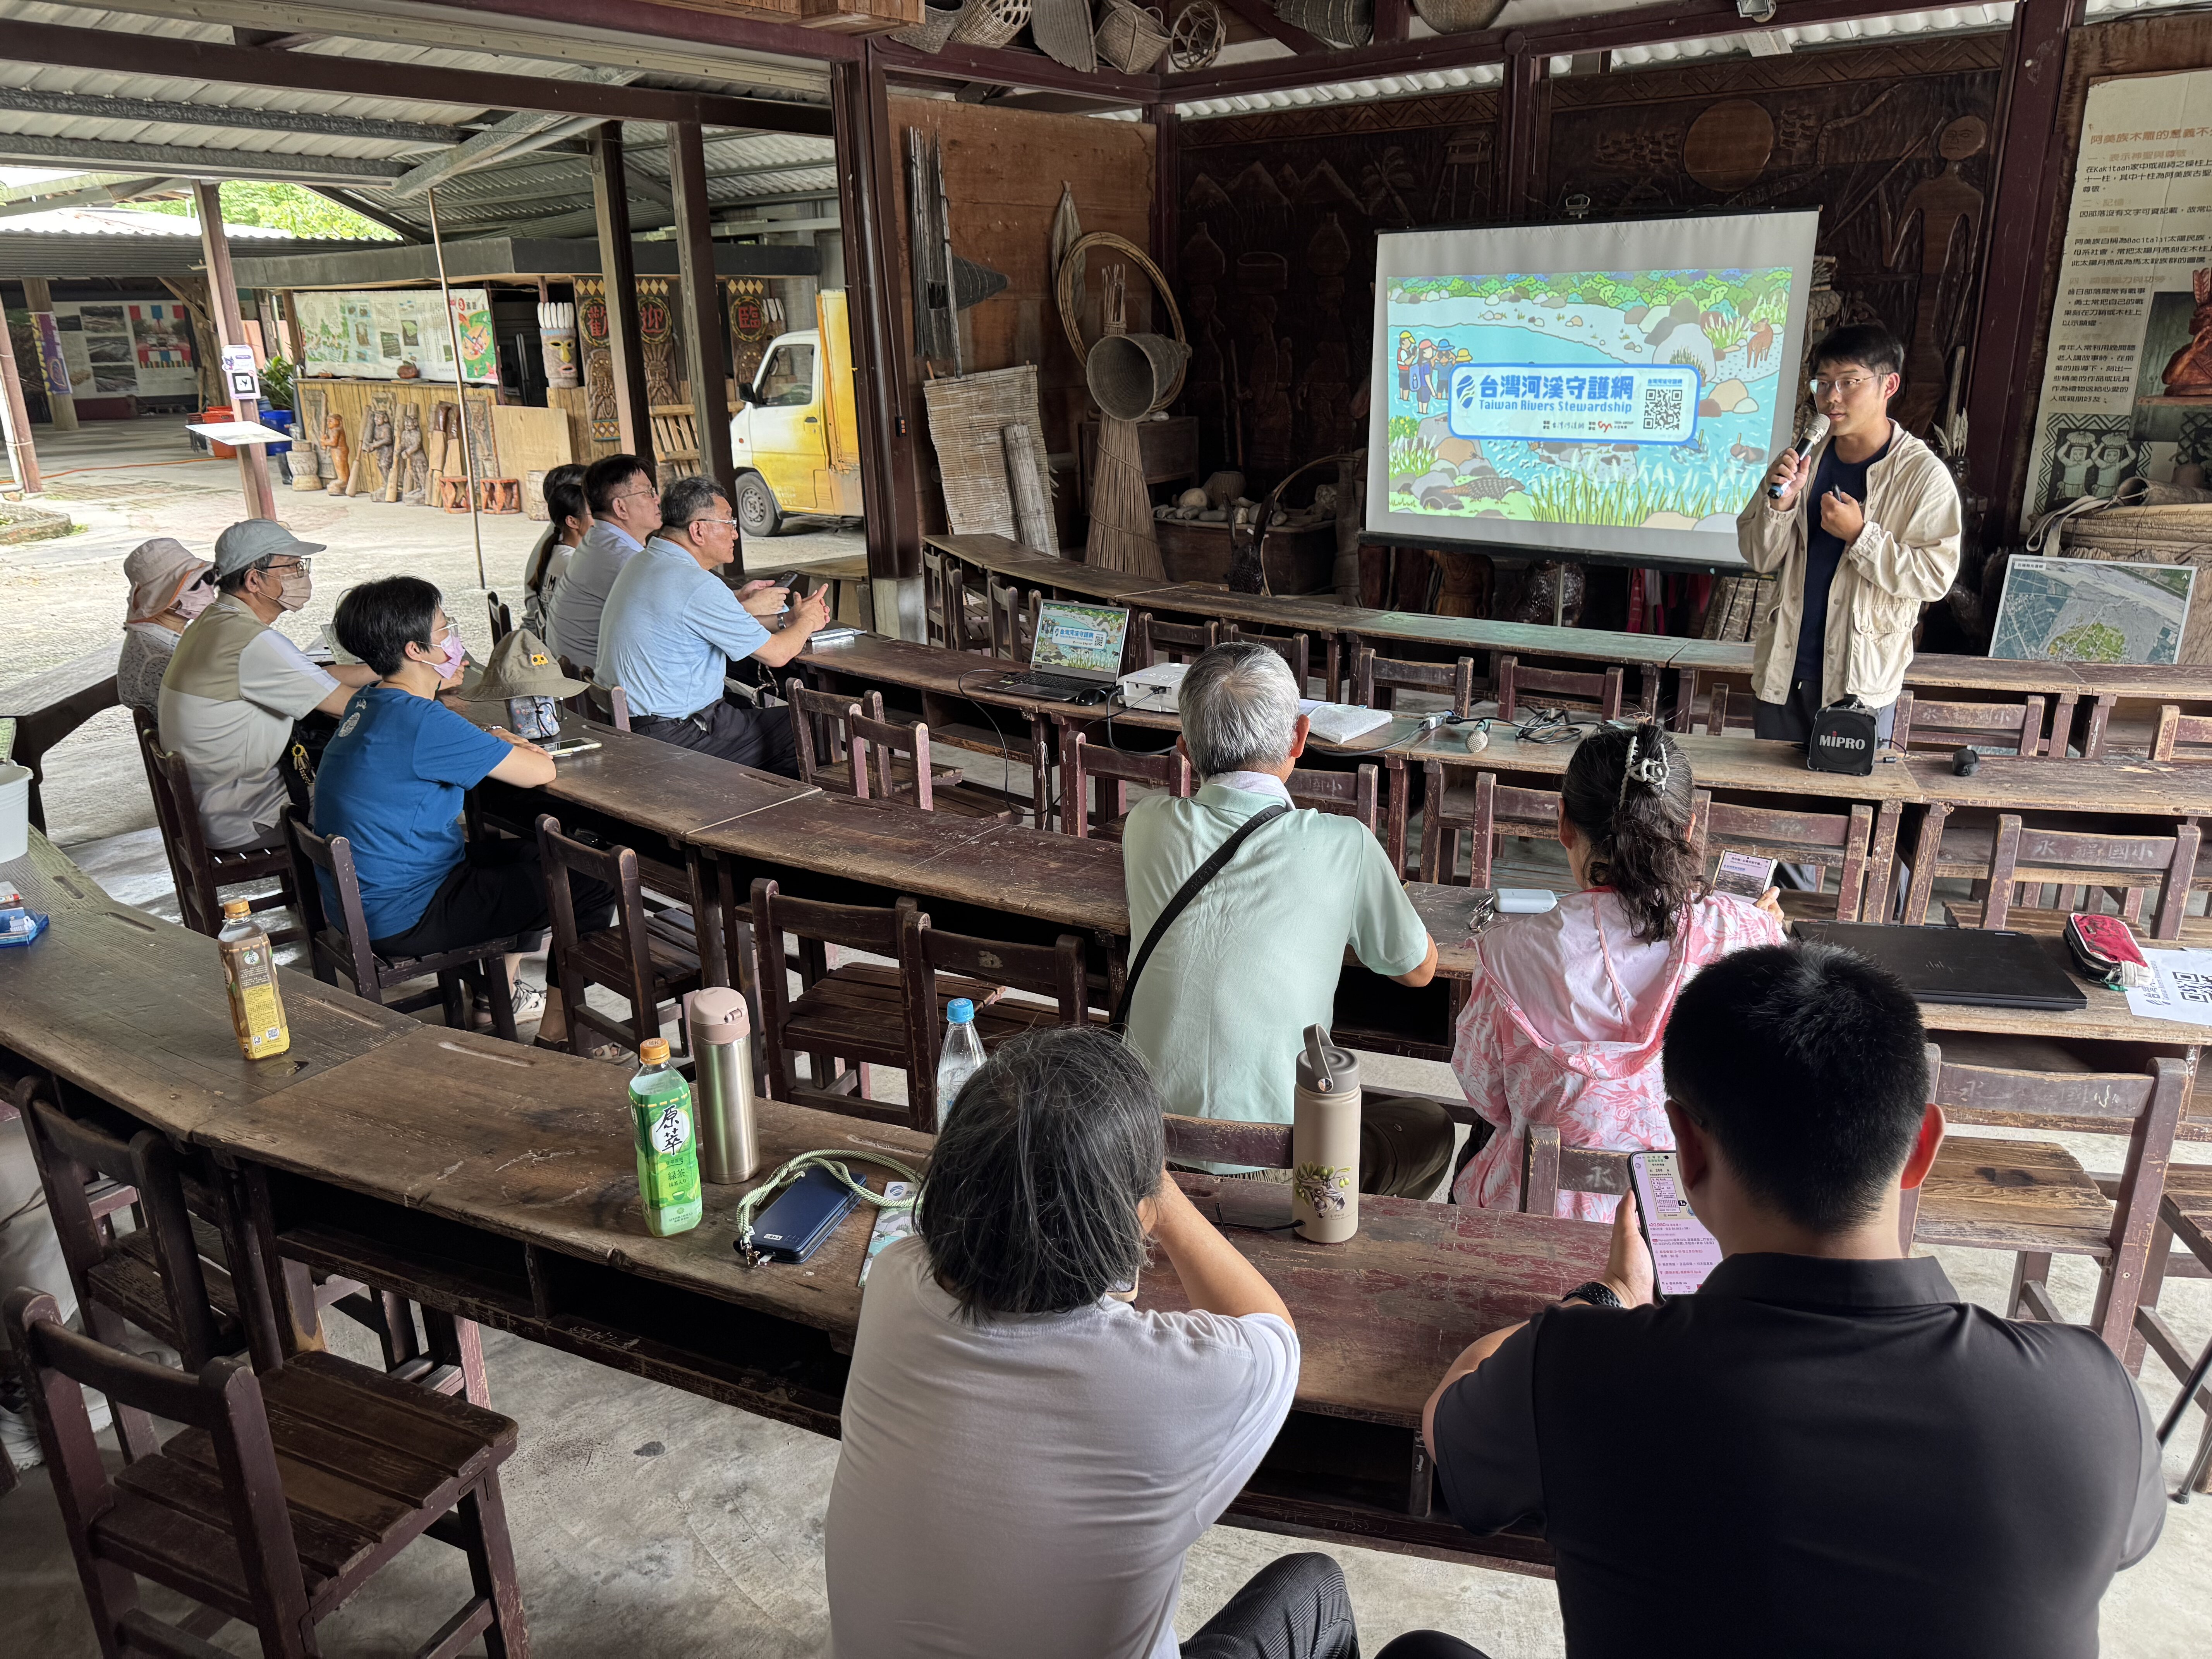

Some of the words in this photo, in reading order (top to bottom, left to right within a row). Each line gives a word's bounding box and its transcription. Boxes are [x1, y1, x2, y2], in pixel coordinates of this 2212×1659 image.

[2090, 127, 2212, 144] 阿美族木雕的意義不
[1479, 374, 1634, 400] 台灣河溪守護網
[1479, 400, 1517, 410] Taiwan
[1521, 401, 1554, 411] Rivers
[1559, 402, 1632, 414] Stewardship
[656, 1105, 683, 1156] 原萃
